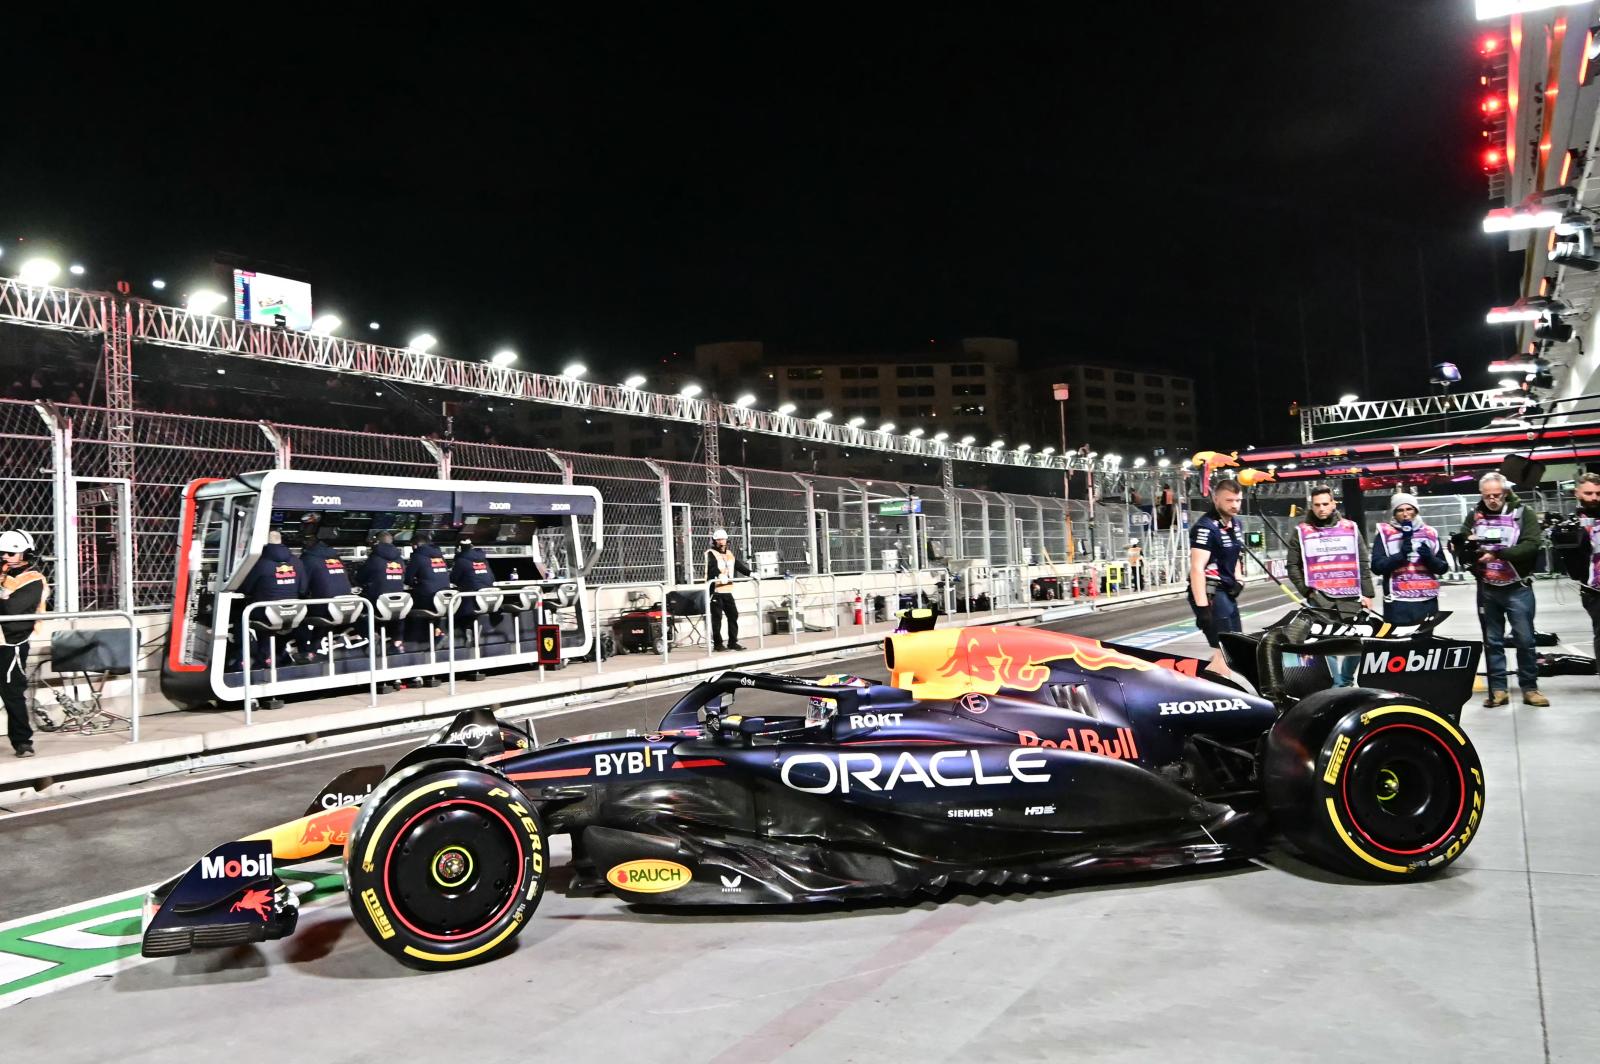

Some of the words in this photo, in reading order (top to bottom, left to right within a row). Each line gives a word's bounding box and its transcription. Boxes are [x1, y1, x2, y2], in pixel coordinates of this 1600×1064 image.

[312, 495, 342, 505] zoom
[397, 498, 423, 508] zoom
[489, 501, 511, 511] zoom
[551, 503, 571, 511] zoom
[1362, 648, 1442, 675] Mobil
[1158, 699, 1252, 716] HONDA
[850, 713, 904, 730] ROKT
[1080, 727, 1139, 760] Bull
[595, 745, 668, 776] BYBIT
[1323, 733, 1351, 786] PIRELLI
[780, 747, 1052, 795] ORACLE
[1470, 767, 1482, 785] P
[322, 792, 369, 809] Clar
[947, 808, 994, 818] SIEMENS
[487, 787, 510, 799] P
[508, 801, 543, 874] ZERO
[1446, 790, 1482, 861] ZERO
[202, 853, 273, 880] Mobil
[629, 868, 681, 883] RAUCH
[361, 887, 396, 940] PIRELLI
